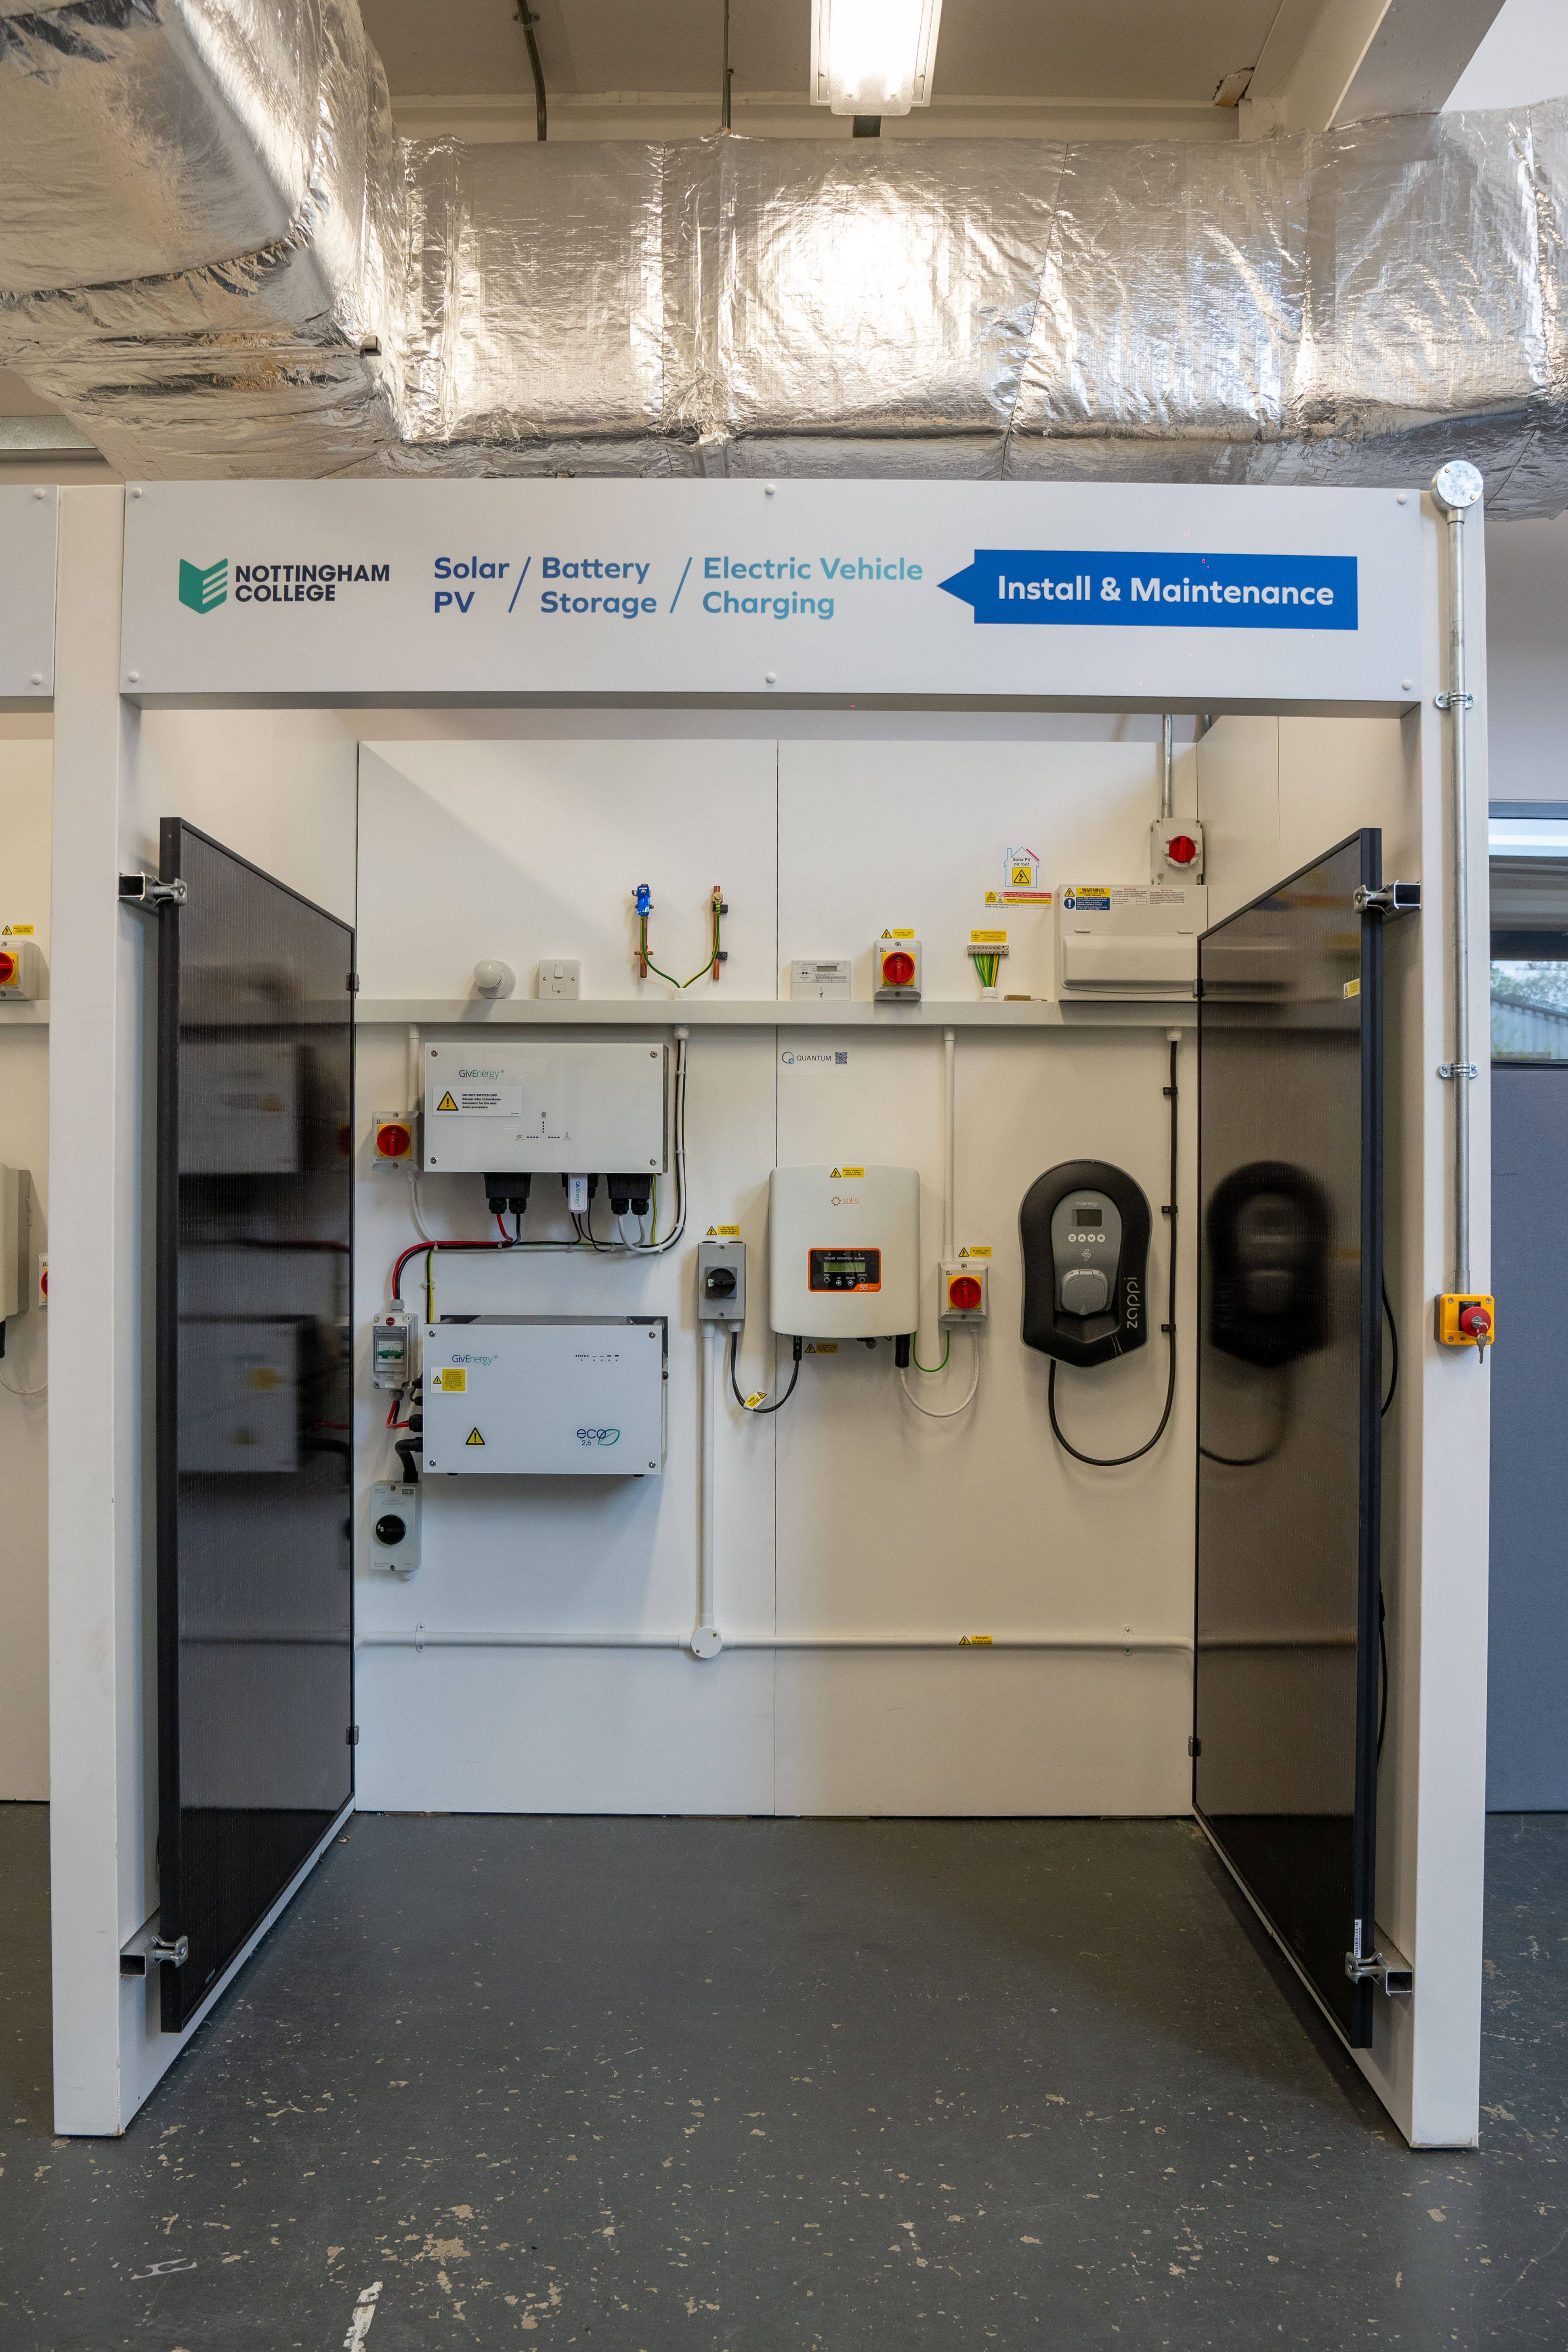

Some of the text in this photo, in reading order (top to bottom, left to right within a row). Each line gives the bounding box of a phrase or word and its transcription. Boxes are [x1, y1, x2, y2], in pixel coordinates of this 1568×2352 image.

[235, 564, 390, 582] NOTTINGHAM
[434, 556, 510, 579] Solar
[542, 556, 651, 584] Battery
[703, 556, 923, 581] Electric Vehicle
[235, 584, 336, 603] COLLEGE
[434, 591, 476, 613] PV
[998, 575, 1334, 606] Install & Maintenance
[540, 591, 657, 619] Storage
[702, 590, 835, 620] Charging
[459, 1069, 499, 1079] GivEnergy
[1124, 1277, 1140, 1328] zappi
[452, 1354, 493, 1365] GivEnergy
[577, 1429, 606, 1438] eco
